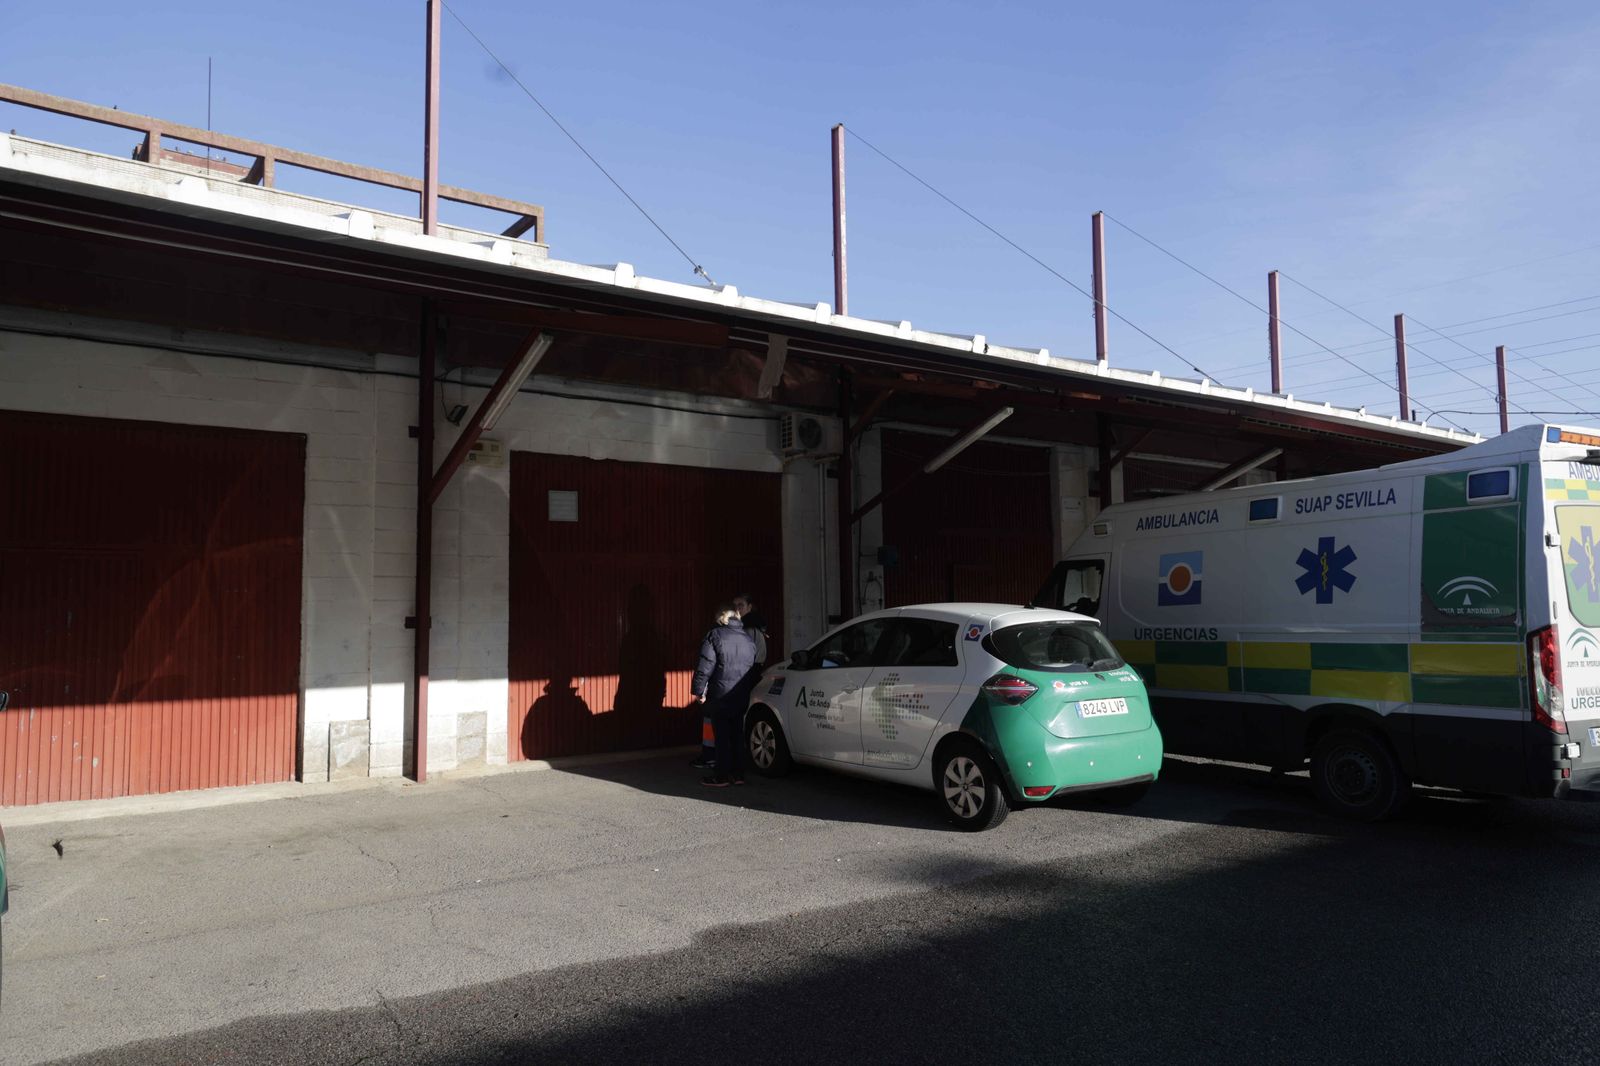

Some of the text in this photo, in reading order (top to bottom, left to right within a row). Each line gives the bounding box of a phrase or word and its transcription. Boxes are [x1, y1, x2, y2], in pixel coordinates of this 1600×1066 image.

[1568, 461, 1600, 481] AMBU
[1295, 488, 1397, 514] SUAP SEVILLA
[1136, 509, 1219, 531] AMBULANCIA
[1134, 627, 1218, 641] URGENCIAS
[1083, 700, 1125, 715] 8249 LVP
